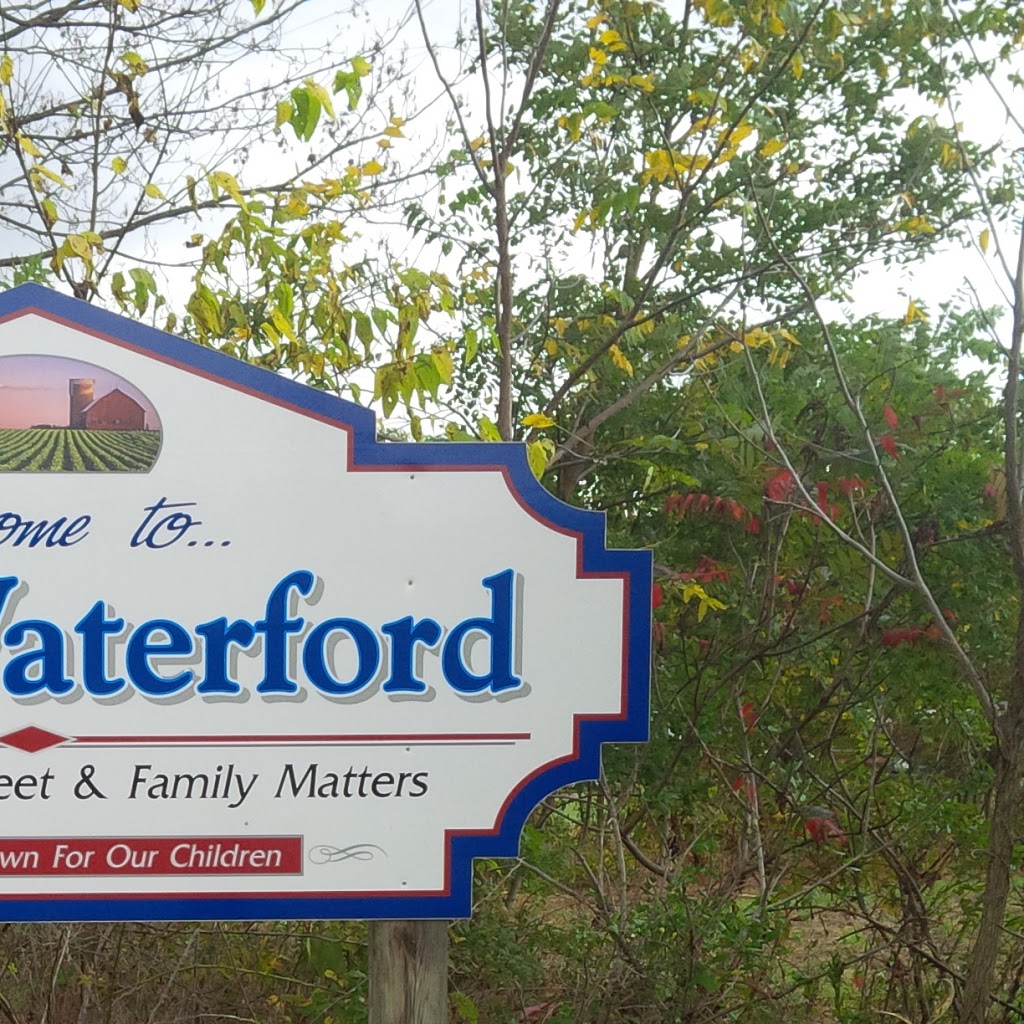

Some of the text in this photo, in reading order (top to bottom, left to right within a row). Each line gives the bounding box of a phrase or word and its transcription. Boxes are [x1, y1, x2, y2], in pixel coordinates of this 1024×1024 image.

[130, 497, 231, 549] to...
[73, 764, 107, 800] &
[127, 763, 259, 809] Family
[275, 763, 429, 799] Matters
[52, 844, 94, 869] For
[106, 844, 158, 869] Our
[169, 842, 282, 869] Children
